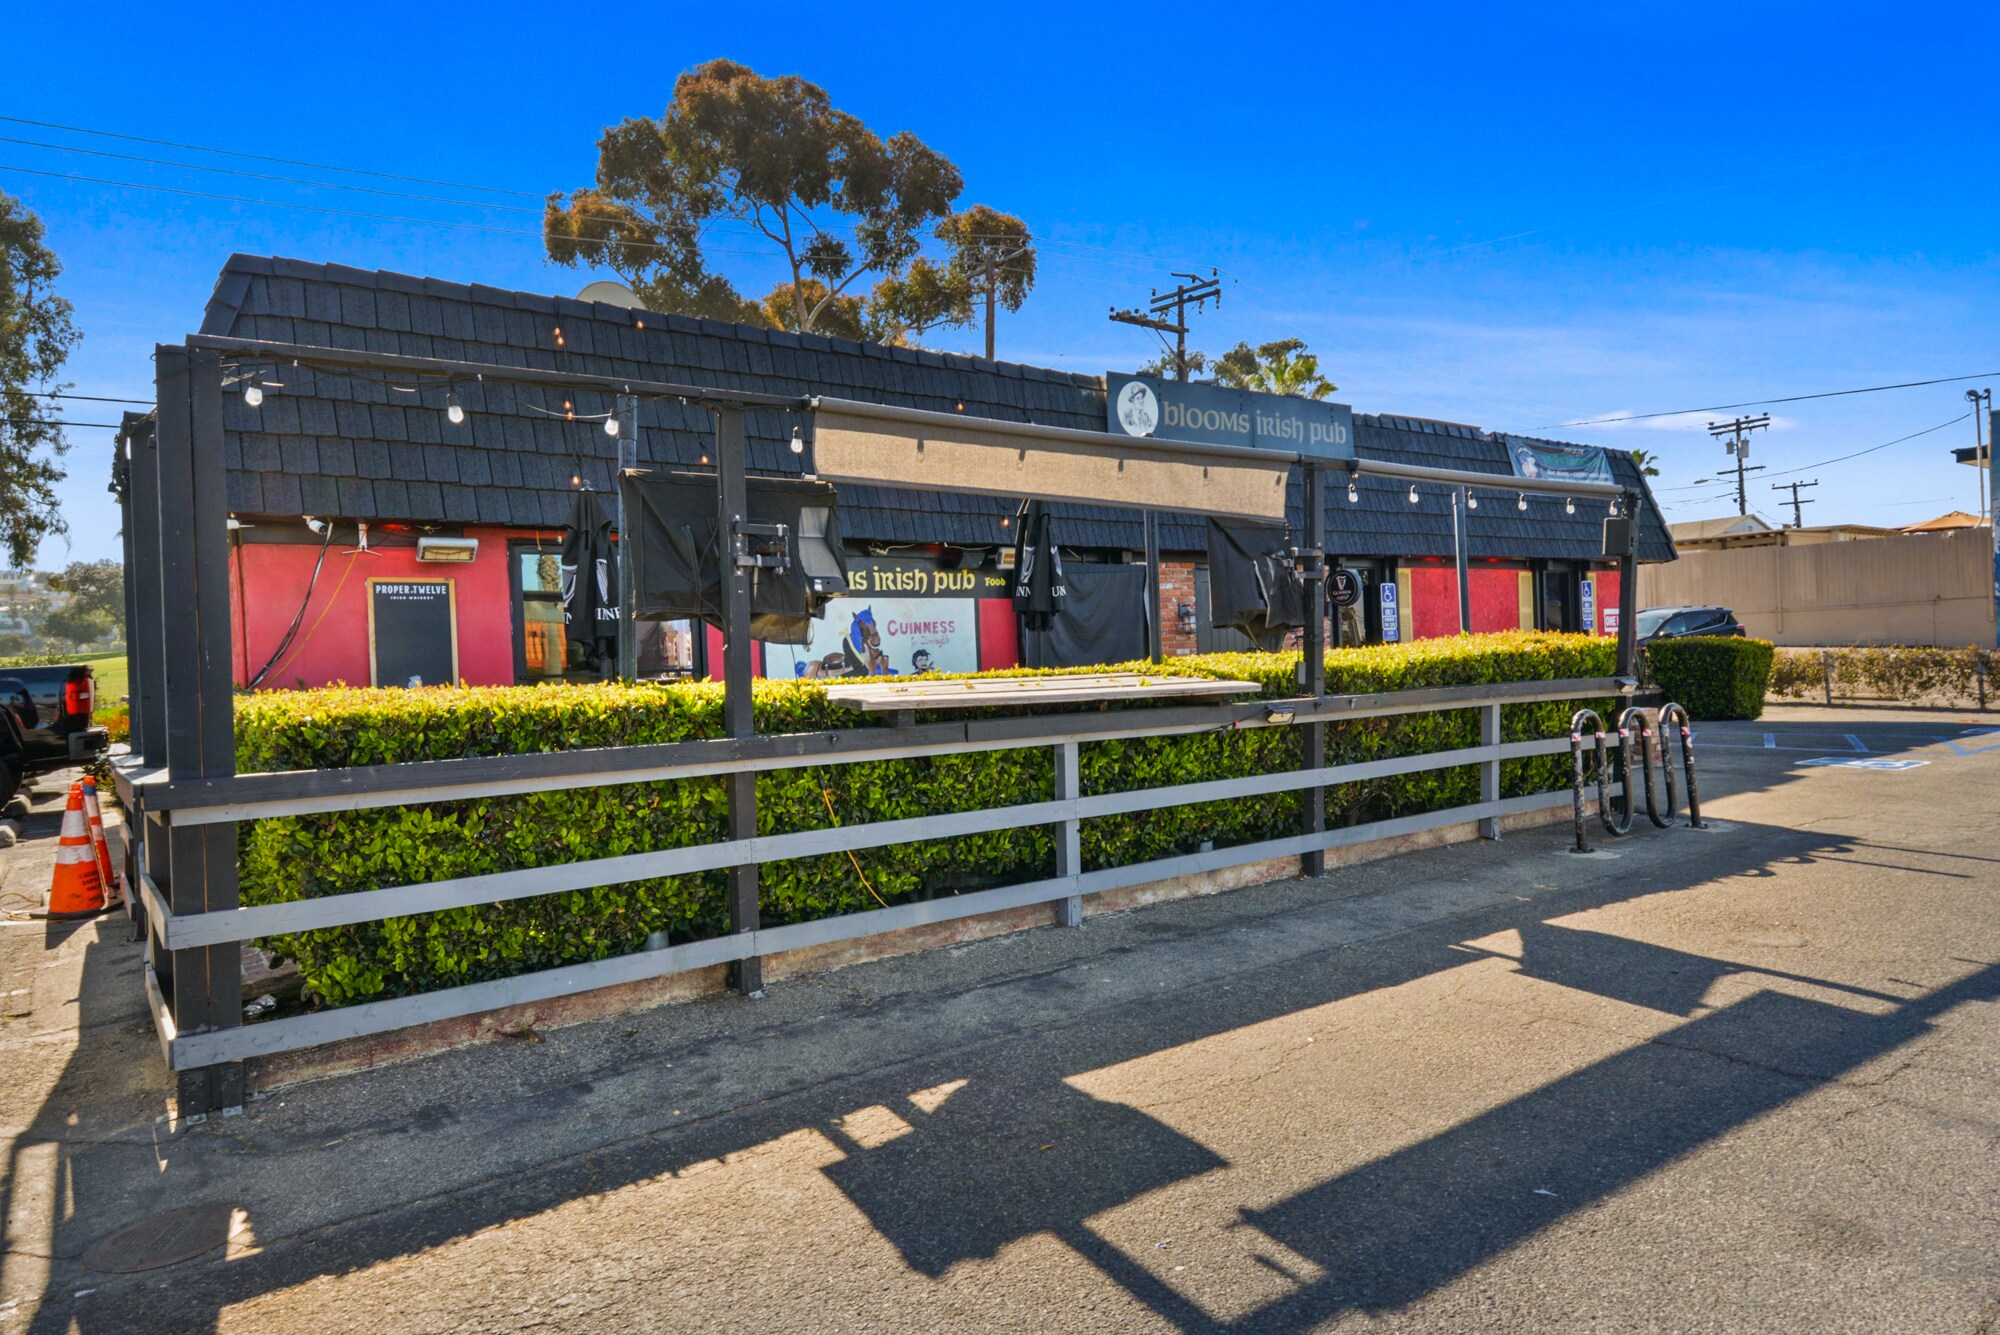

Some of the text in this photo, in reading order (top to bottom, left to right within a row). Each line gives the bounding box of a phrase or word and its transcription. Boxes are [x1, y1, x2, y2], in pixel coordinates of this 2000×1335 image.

[1256, 409, 1304, 443] irish
[1310, 421, 1347, 445] pub
[873, 565, 928, 594] irish
[933, 568, 976, 594] pub
[887, 620, 956, 637] GUINNESS
